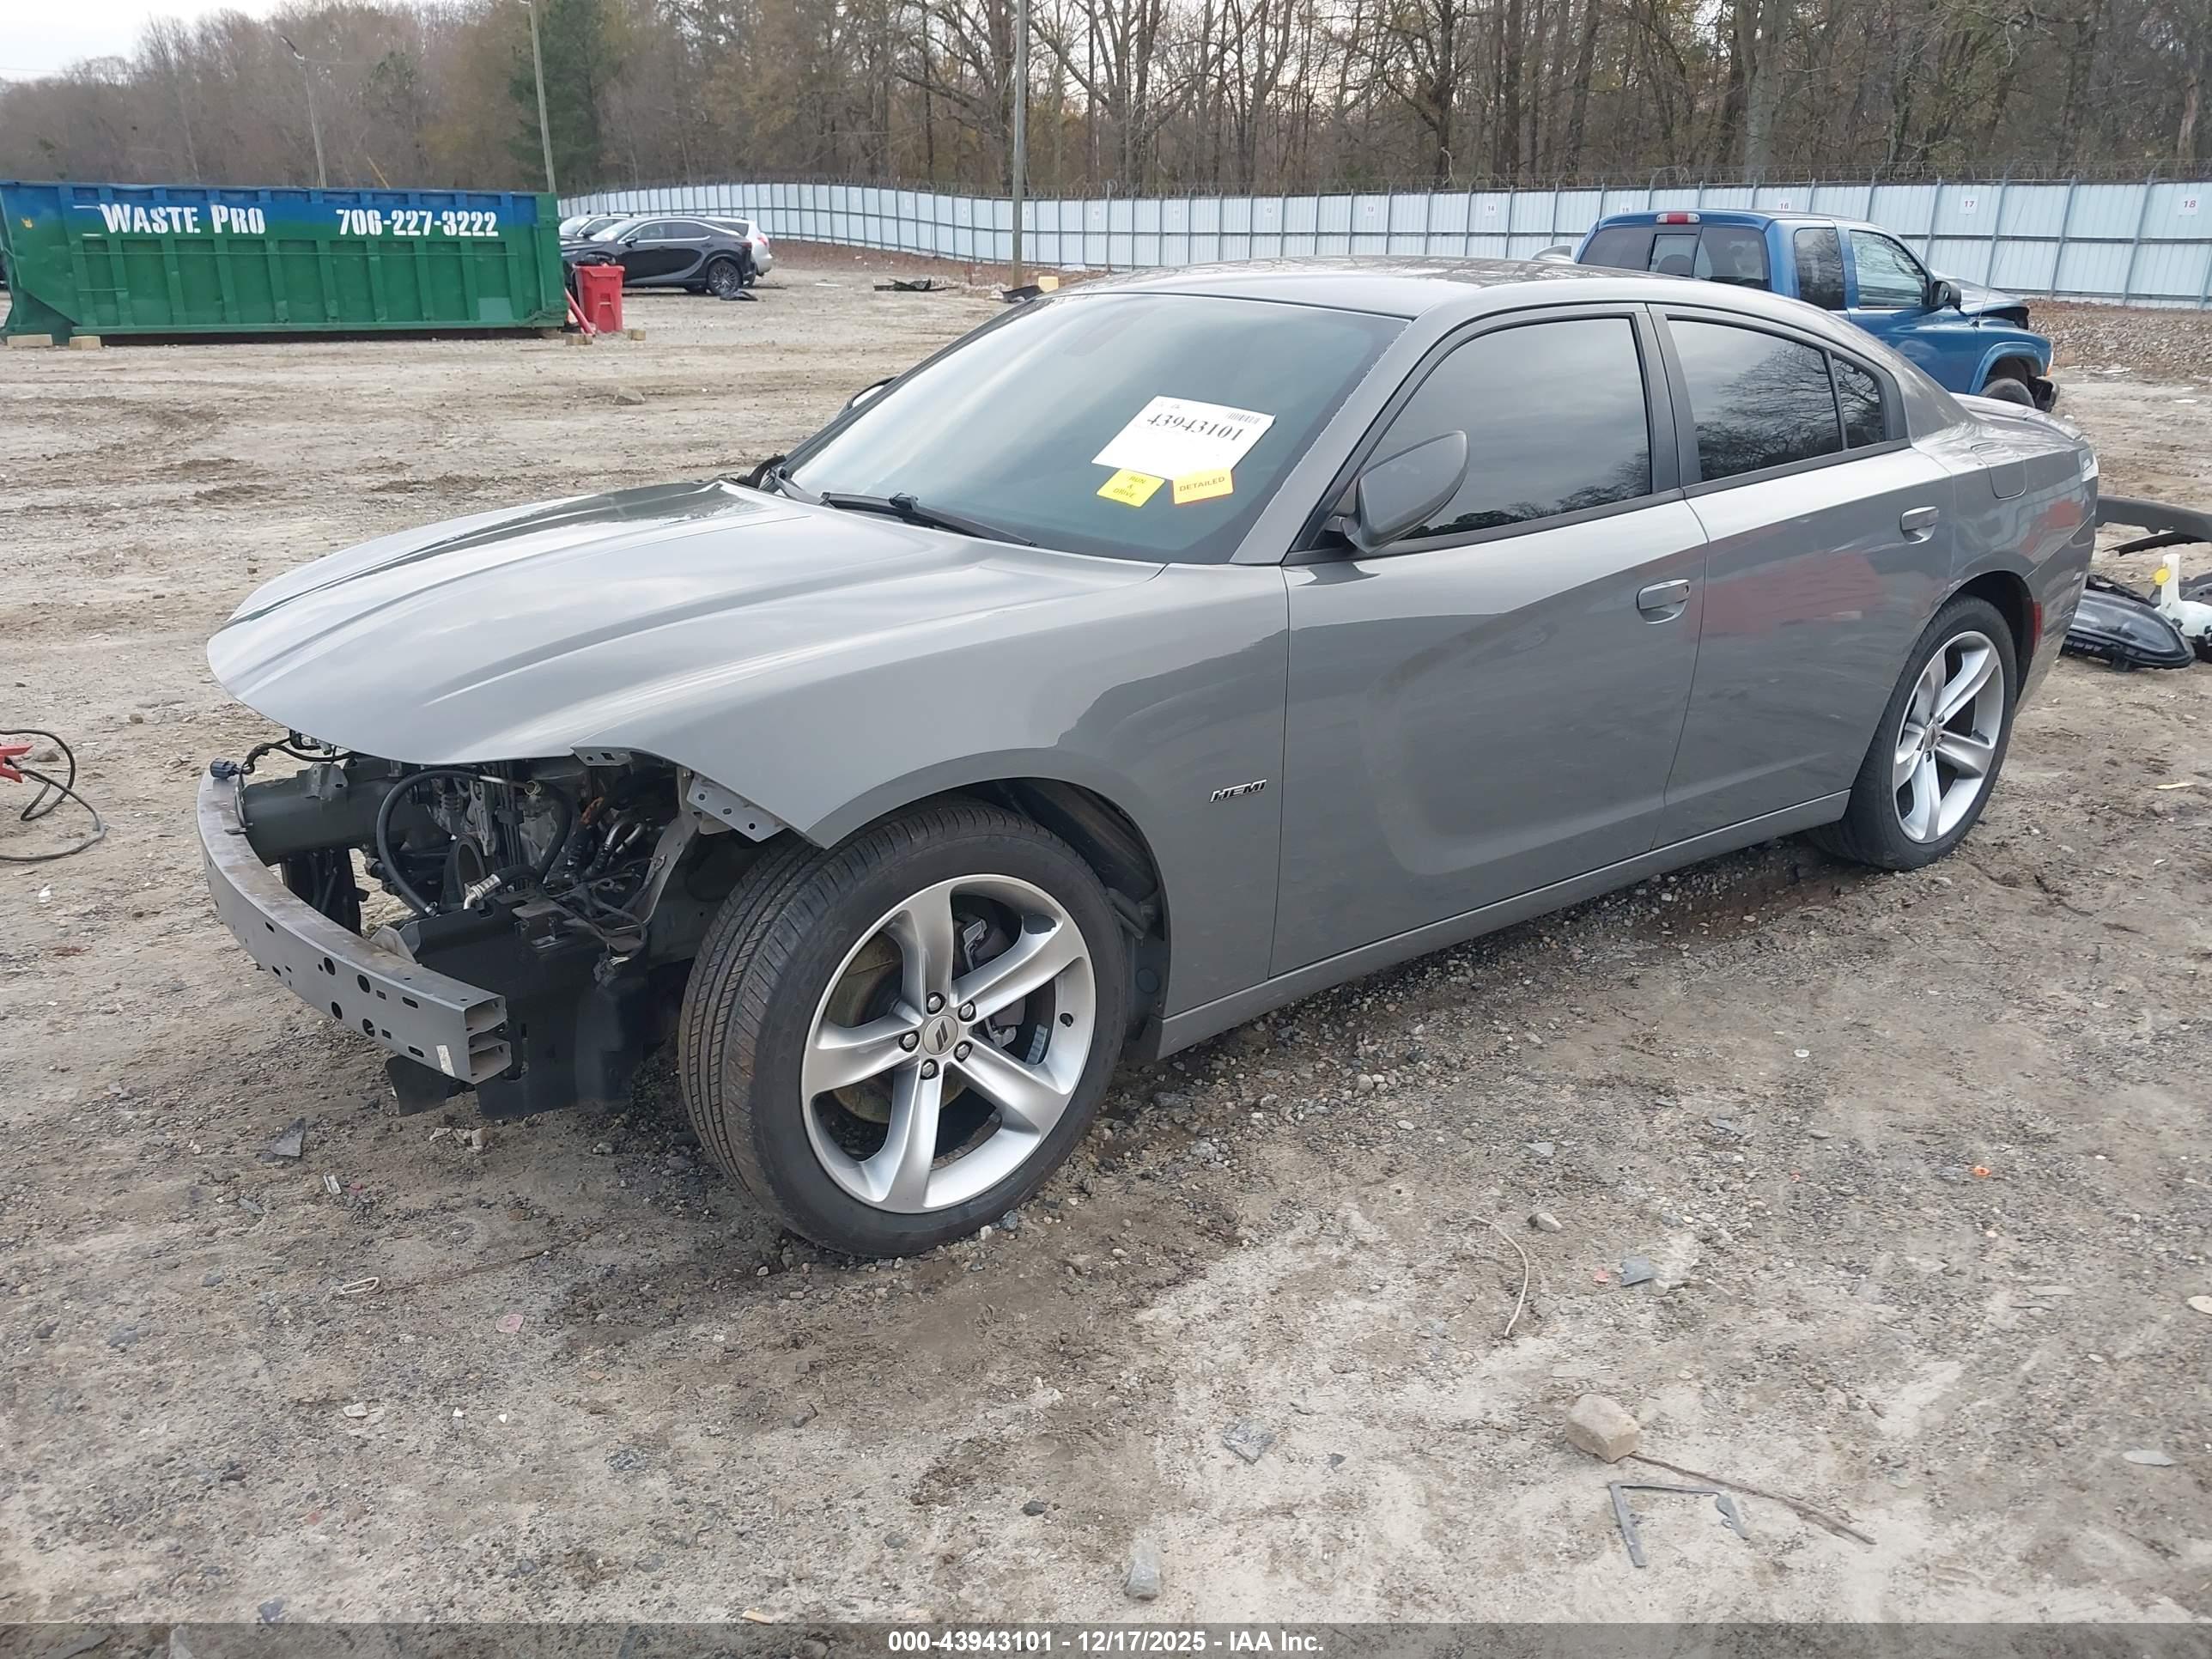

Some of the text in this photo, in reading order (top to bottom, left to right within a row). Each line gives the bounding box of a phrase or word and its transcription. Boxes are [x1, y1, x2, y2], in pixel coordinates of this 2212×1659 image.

[2184, 199, 2197, 209] 18
[99, 204, 265, 234] WASTE PRO
[336, 209, 499, 237] 706-227-3222
[1147, 413, 1243, 441] 43943101
[1113, 488, 1139, 498] DRIVE
[1179, 476, 1225, 492] DETAILED
[1209, 779, 1267, 802] HEMI
